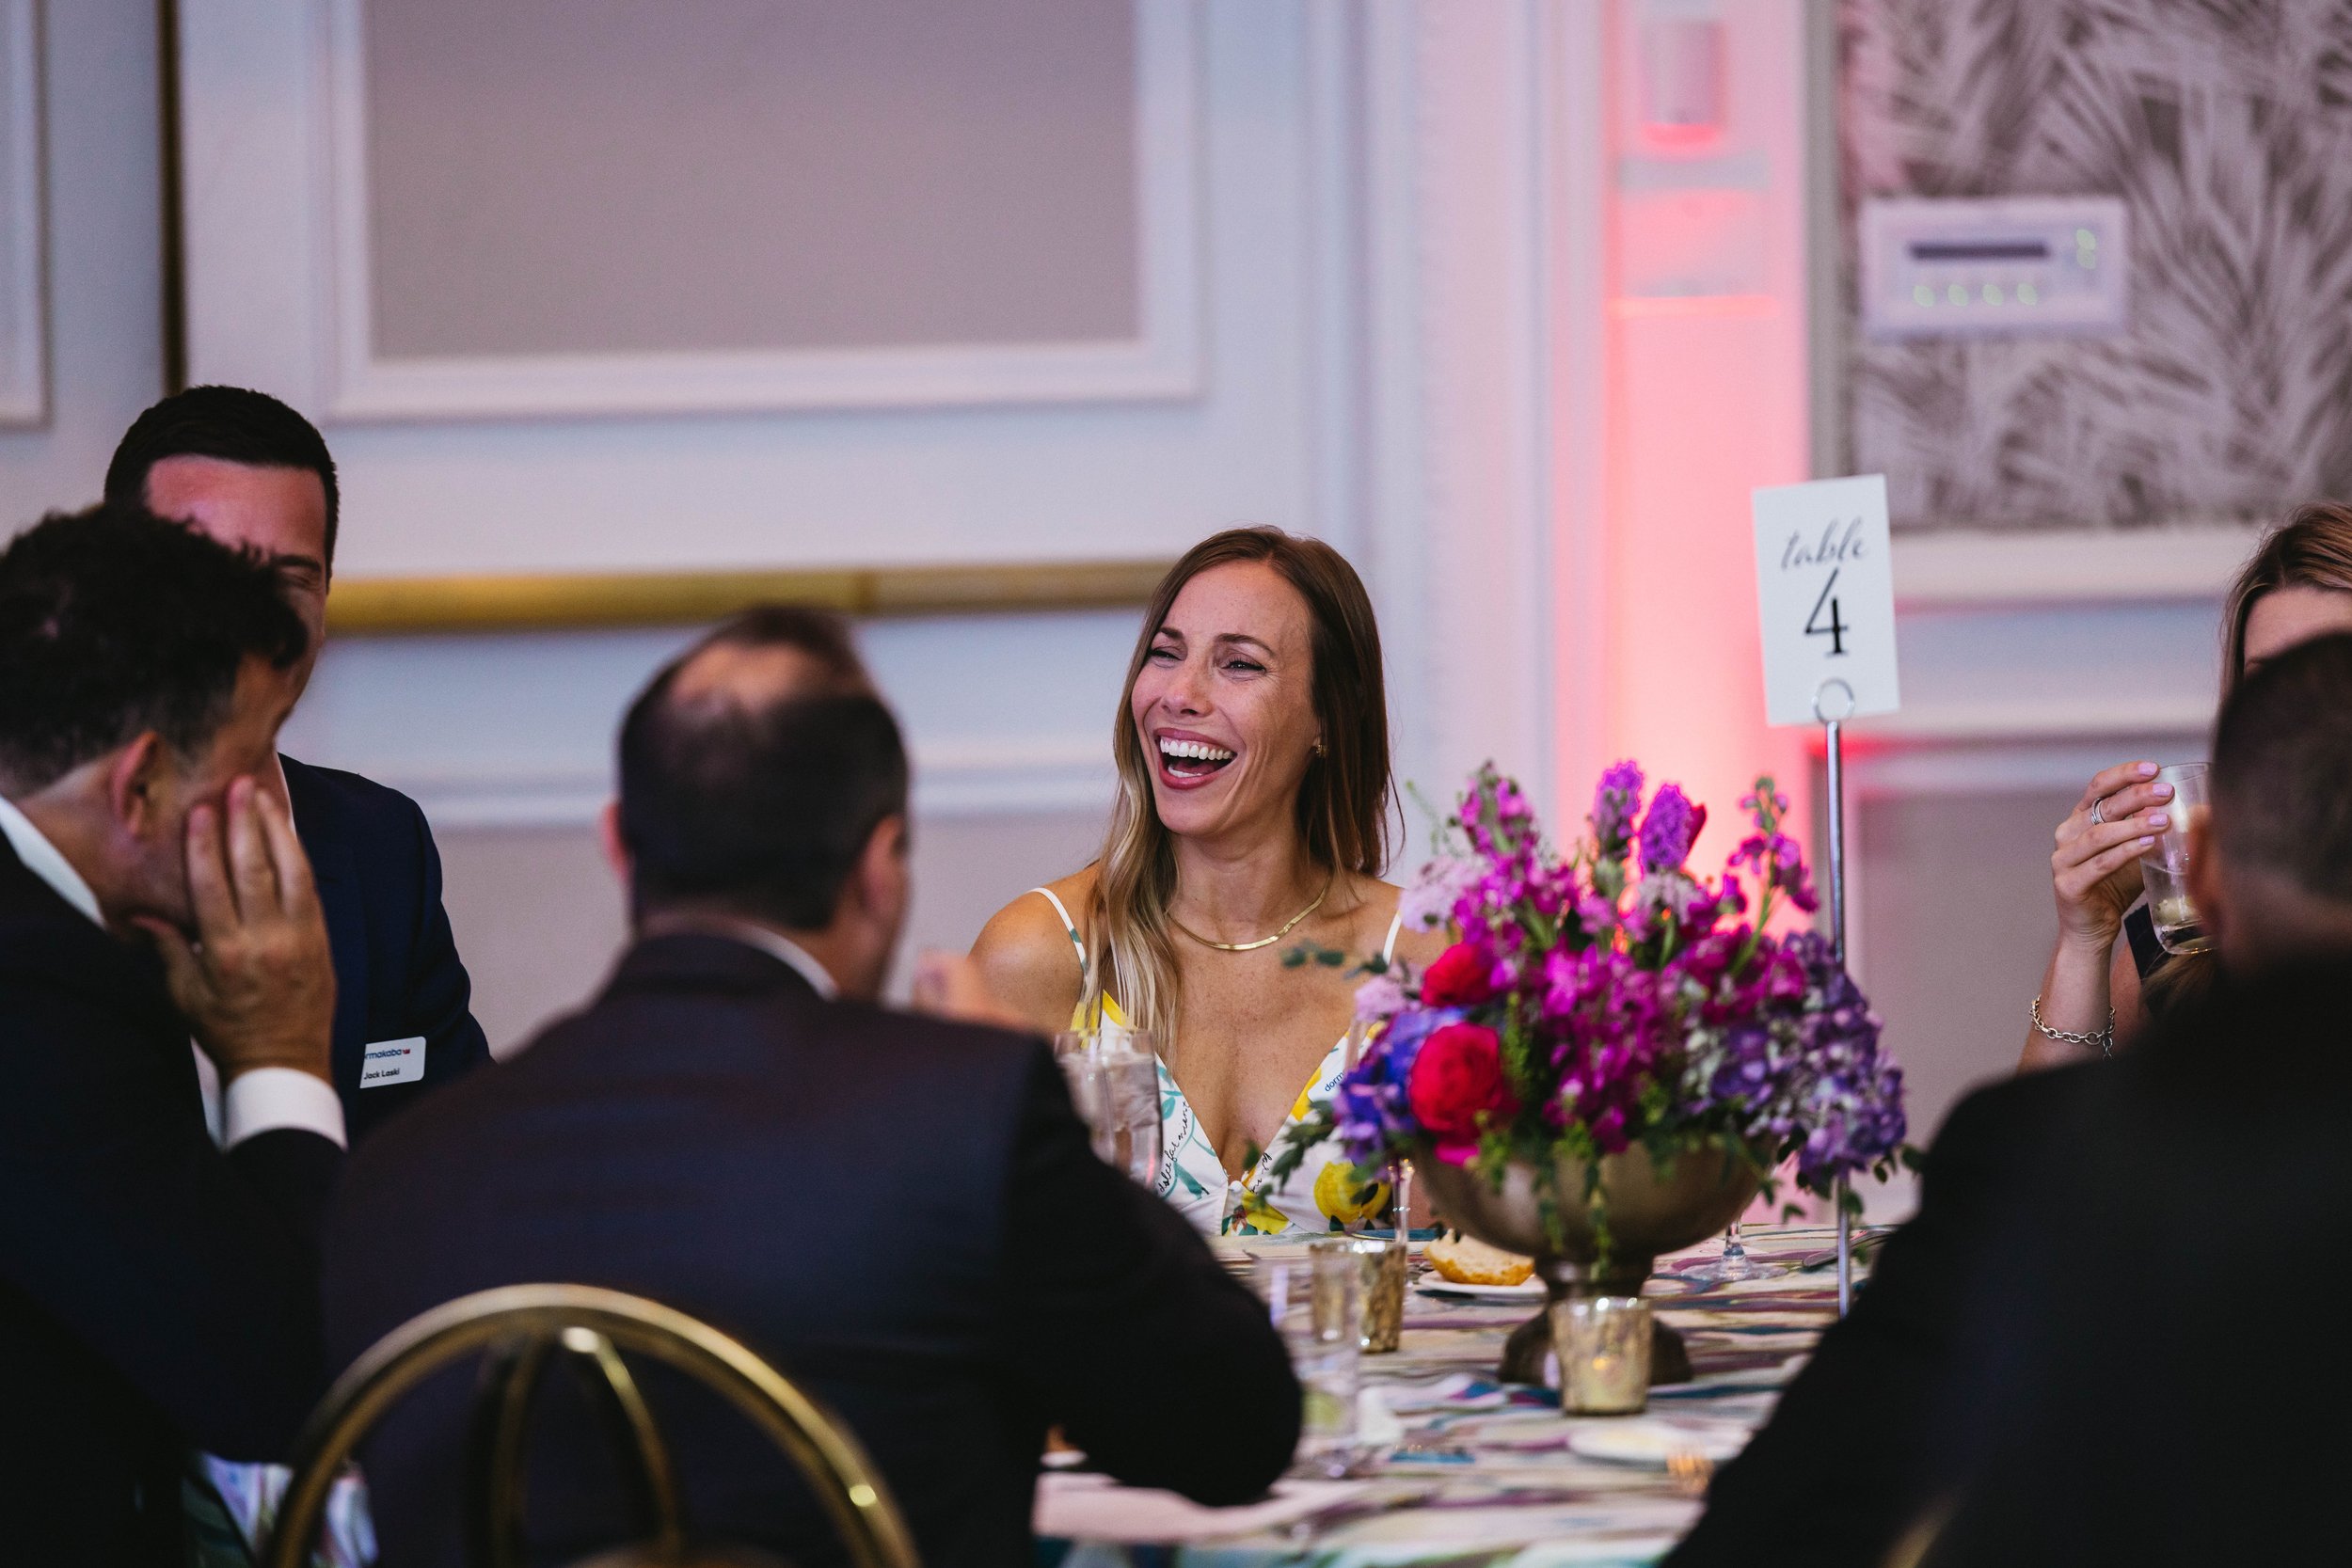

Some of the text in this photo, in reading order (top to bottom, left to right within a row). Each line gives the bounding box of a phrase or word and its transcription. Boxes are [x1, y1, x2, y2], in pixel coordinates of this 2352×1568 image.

[1781, 516, 1867, 569] table
[1804, 566, 1849, 657] 4
[364, 1049, 402, 1060] rmakaba
[363, 1070, 380, 1080] Jack
[1325, 1071, 1344, 1092] dorm
